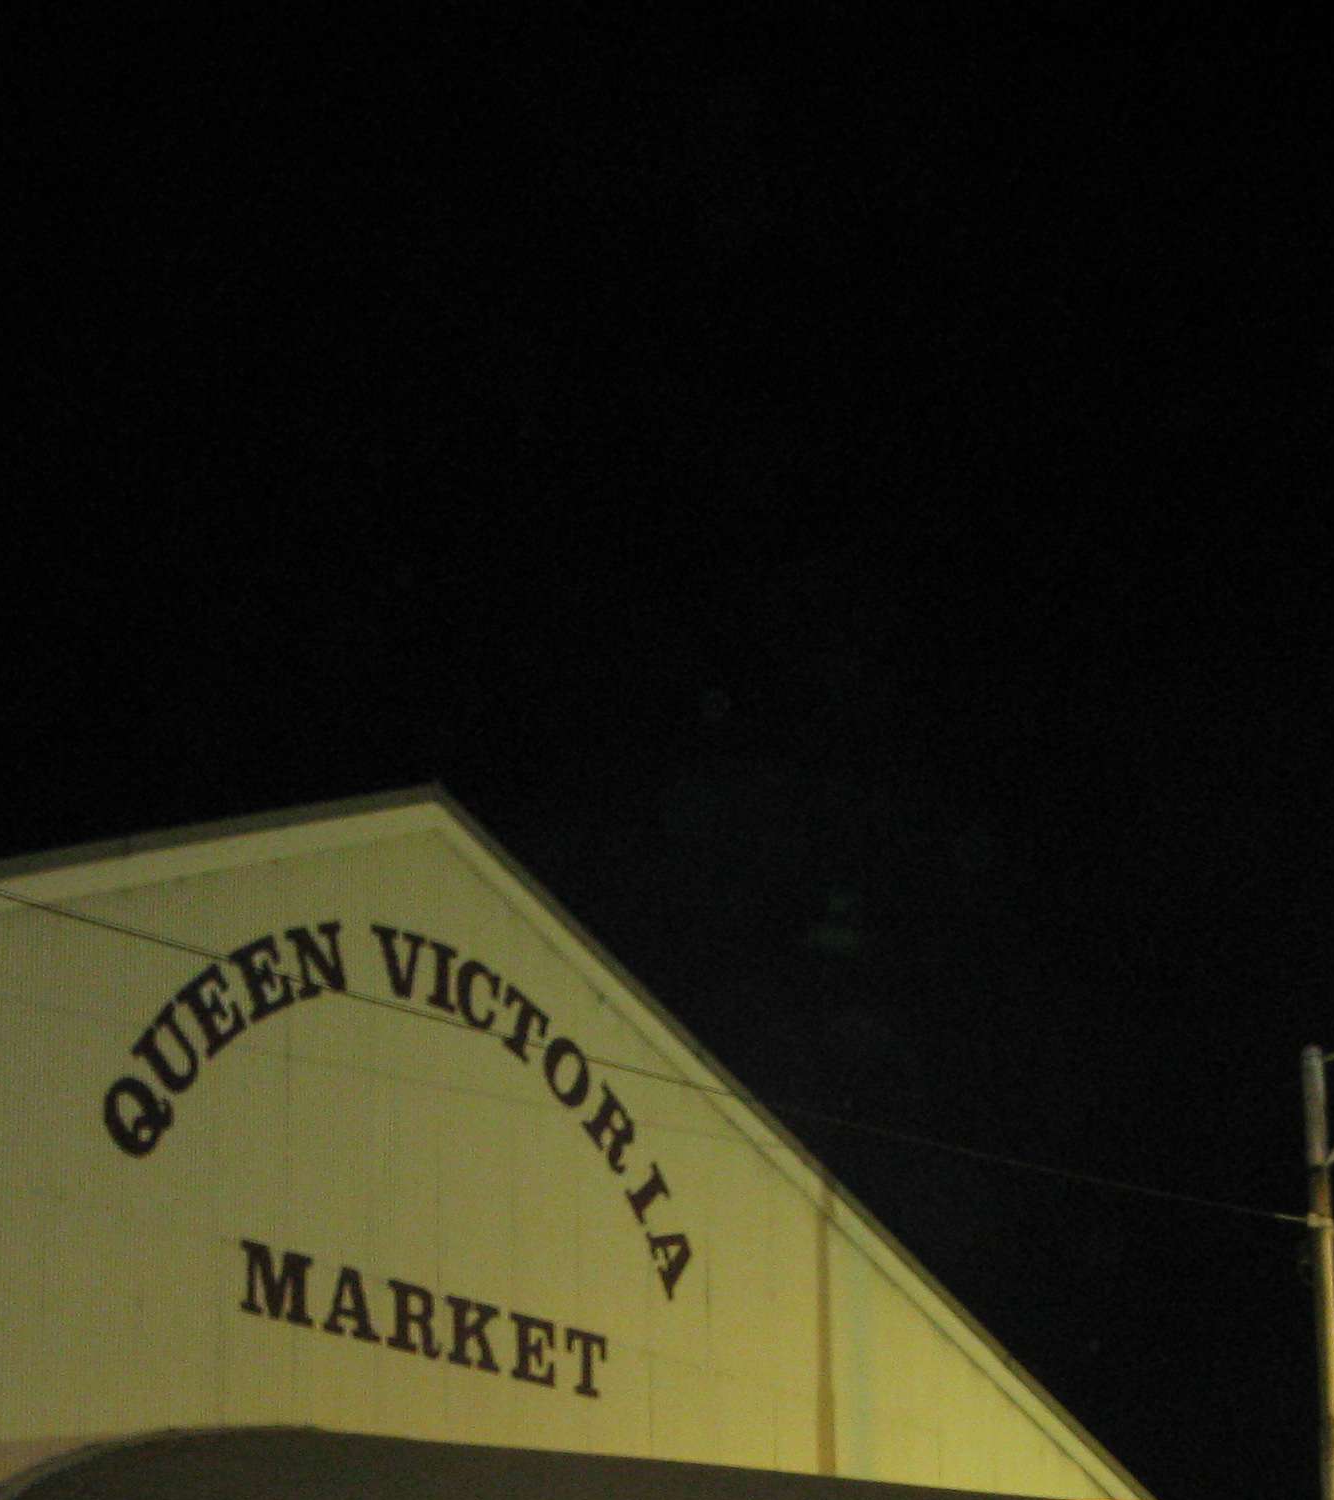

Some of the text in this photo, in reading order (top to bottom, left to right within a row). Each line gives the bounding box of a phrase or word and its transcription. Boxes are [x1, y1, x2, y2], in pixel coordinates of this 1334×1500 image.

[104, 921, 692, 1301] QUEEN VICTORIA
[240, 1239, 608, 1399] MARKET
